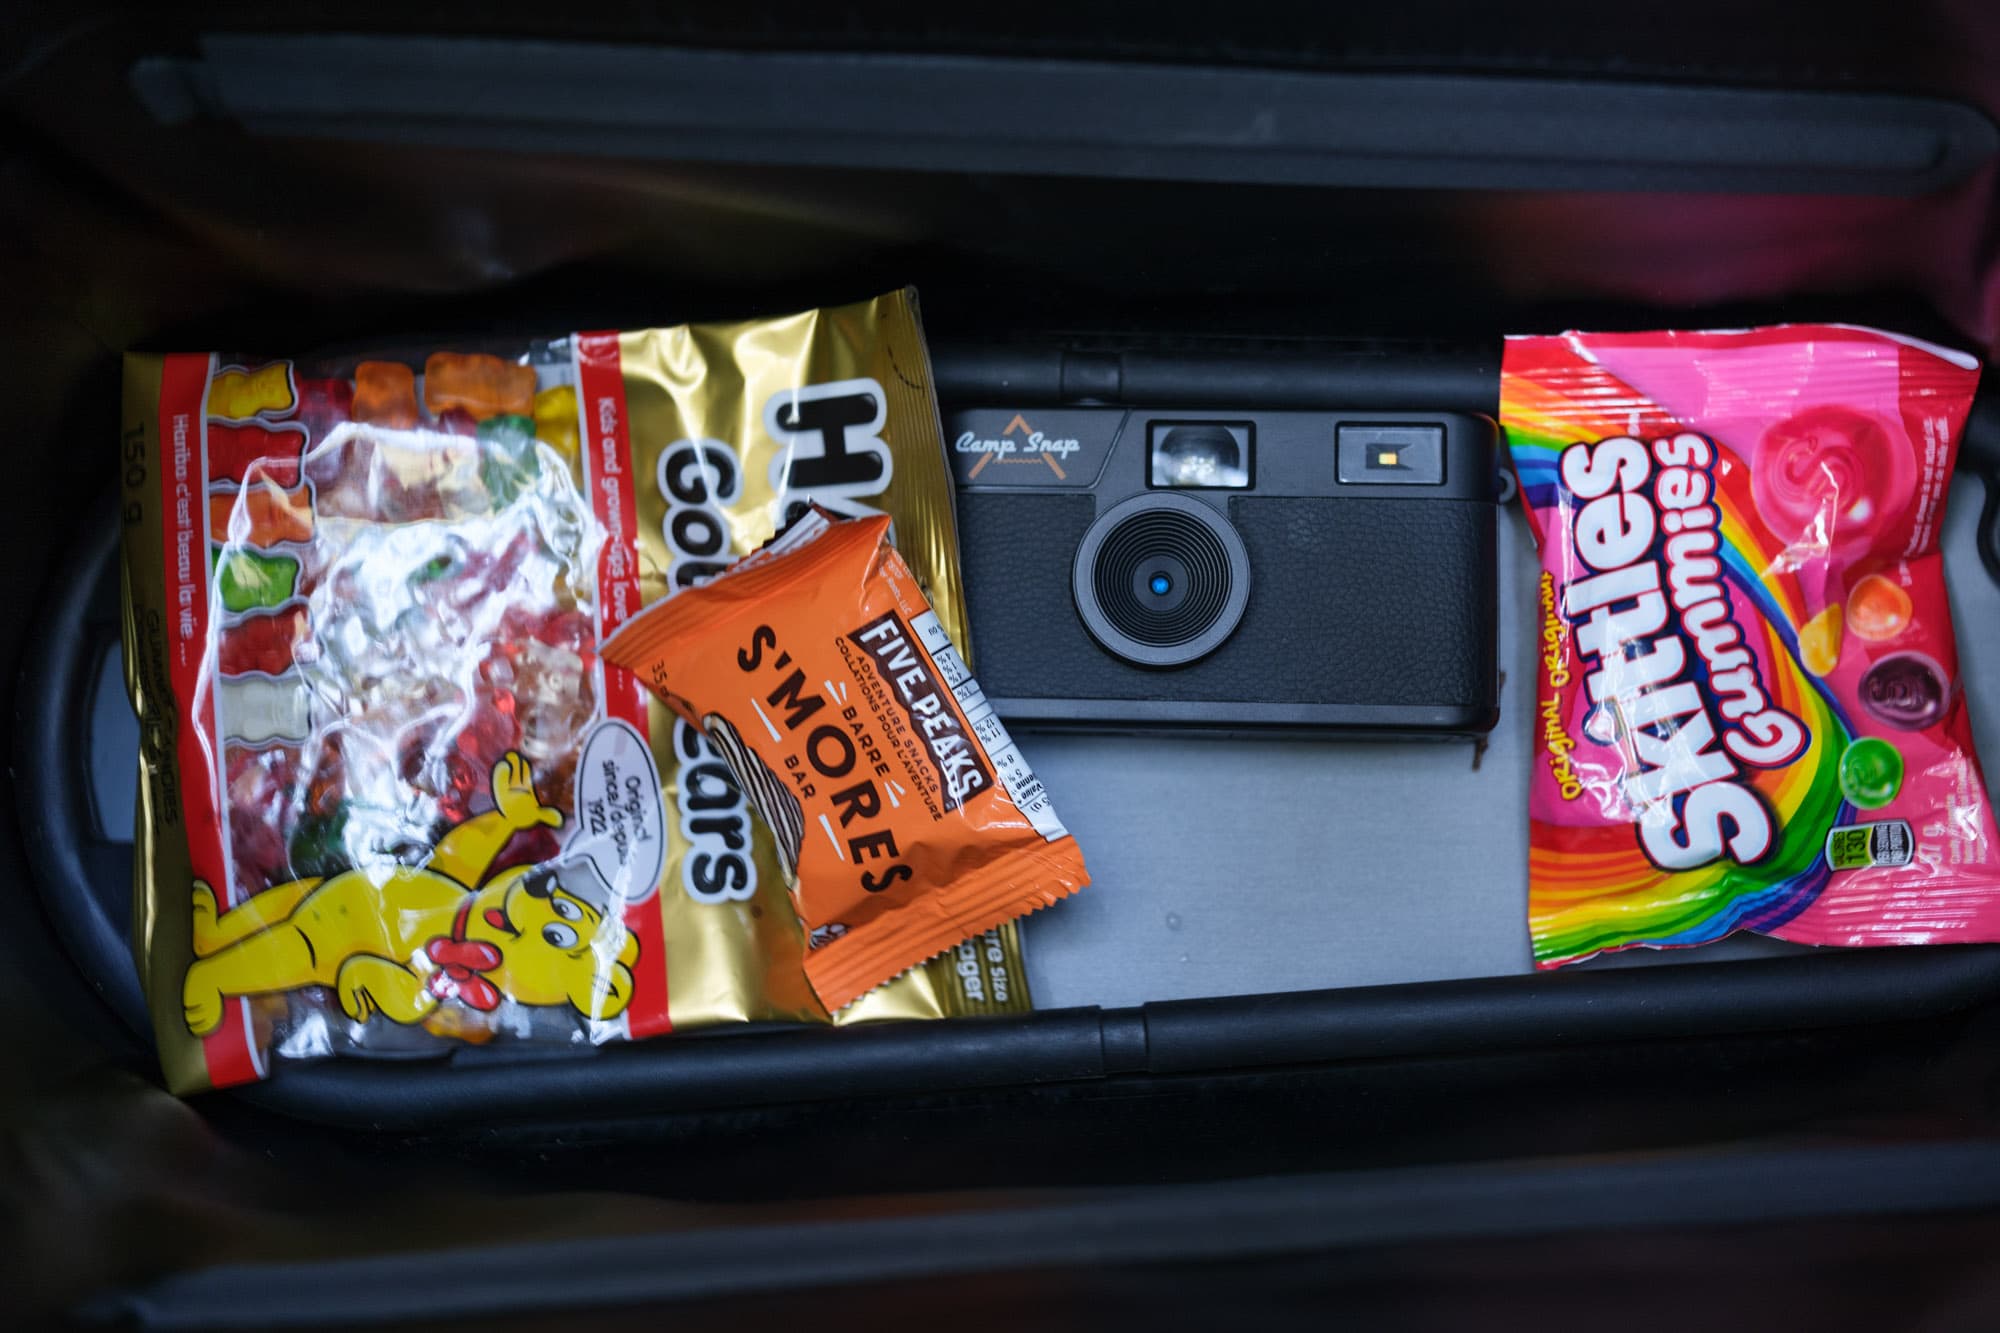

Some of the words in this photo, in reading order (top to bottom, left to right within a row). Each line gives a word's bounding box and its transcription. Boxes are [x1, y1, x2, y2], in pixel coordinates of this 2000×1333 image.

[598, 397, 617, 435] Kids
[173, 414, 191, 480] Haribo
[602, 436, 621, 475] and
[955, 431, 1016, 460] Camp
[1023, 432, 1080, 460] Snap
[176, 482, 191, 528] c'est
[601, 476, 625, 578] grown-ups
[177, 530, 194, 583] beau
[179, 584, 196, 605] la
[612, 581, 629, 622] love
[1653, 433, 1809, 767] Gummies
[180, 606, 198, 639] vie
[1562, 436, 1772, 868] Skittles
[835, 637, 880, 713] COLLATIONS
[877, 715, 900, 748] POUR
[898, 749, 943, 822] L'AVENTURE
[857, 656, 906, 735] ADVENTURE
[904, 740, 938, 793] SNACKS
[860, 619, 927, 702] FIVE
[912, 692, 983, 801] PEAKS
[737, 624, 912, 893] S'MORES
[842, 706, 891, 778] BARRE
[784, 754, 816, 799] BAR
[588, 798, 607, 836] 1922
[1846, 829, 1866, 863] 130
[956, 942, 985, 1002] ager
[990, 966, 1008, 1002] size
